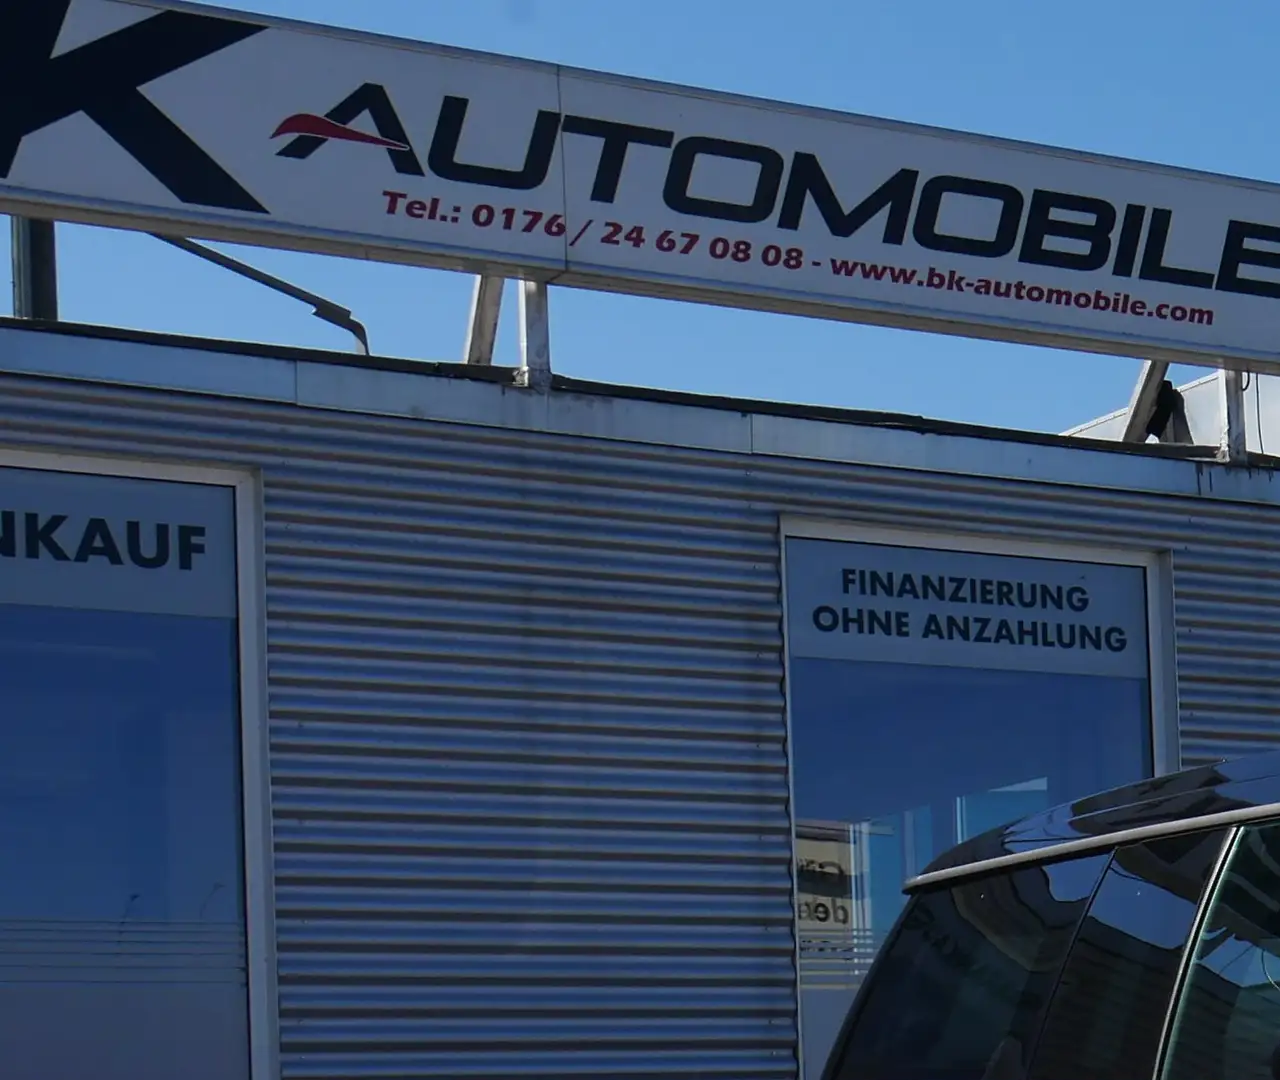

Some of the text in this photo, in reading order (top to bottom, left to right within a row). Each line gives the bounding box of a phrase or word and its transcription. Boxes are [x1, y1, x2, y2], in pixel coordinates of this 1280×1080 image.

[382, 190, 462, 224] Tel.:
[472, 203, 567, 238] 0176
[600, 221, 646, 249] 24
[655, 230, 700, 256] 67
[708, 237, 752, 264] 08
[760, 244, 804, 270] 08
[830, 256, 1216, 326] www.bk-automobile.com
[841, 568, 1090, 612] FINANZIERUNG
[812, 605, 1128, 652] OHNE ANZAHLUNG
